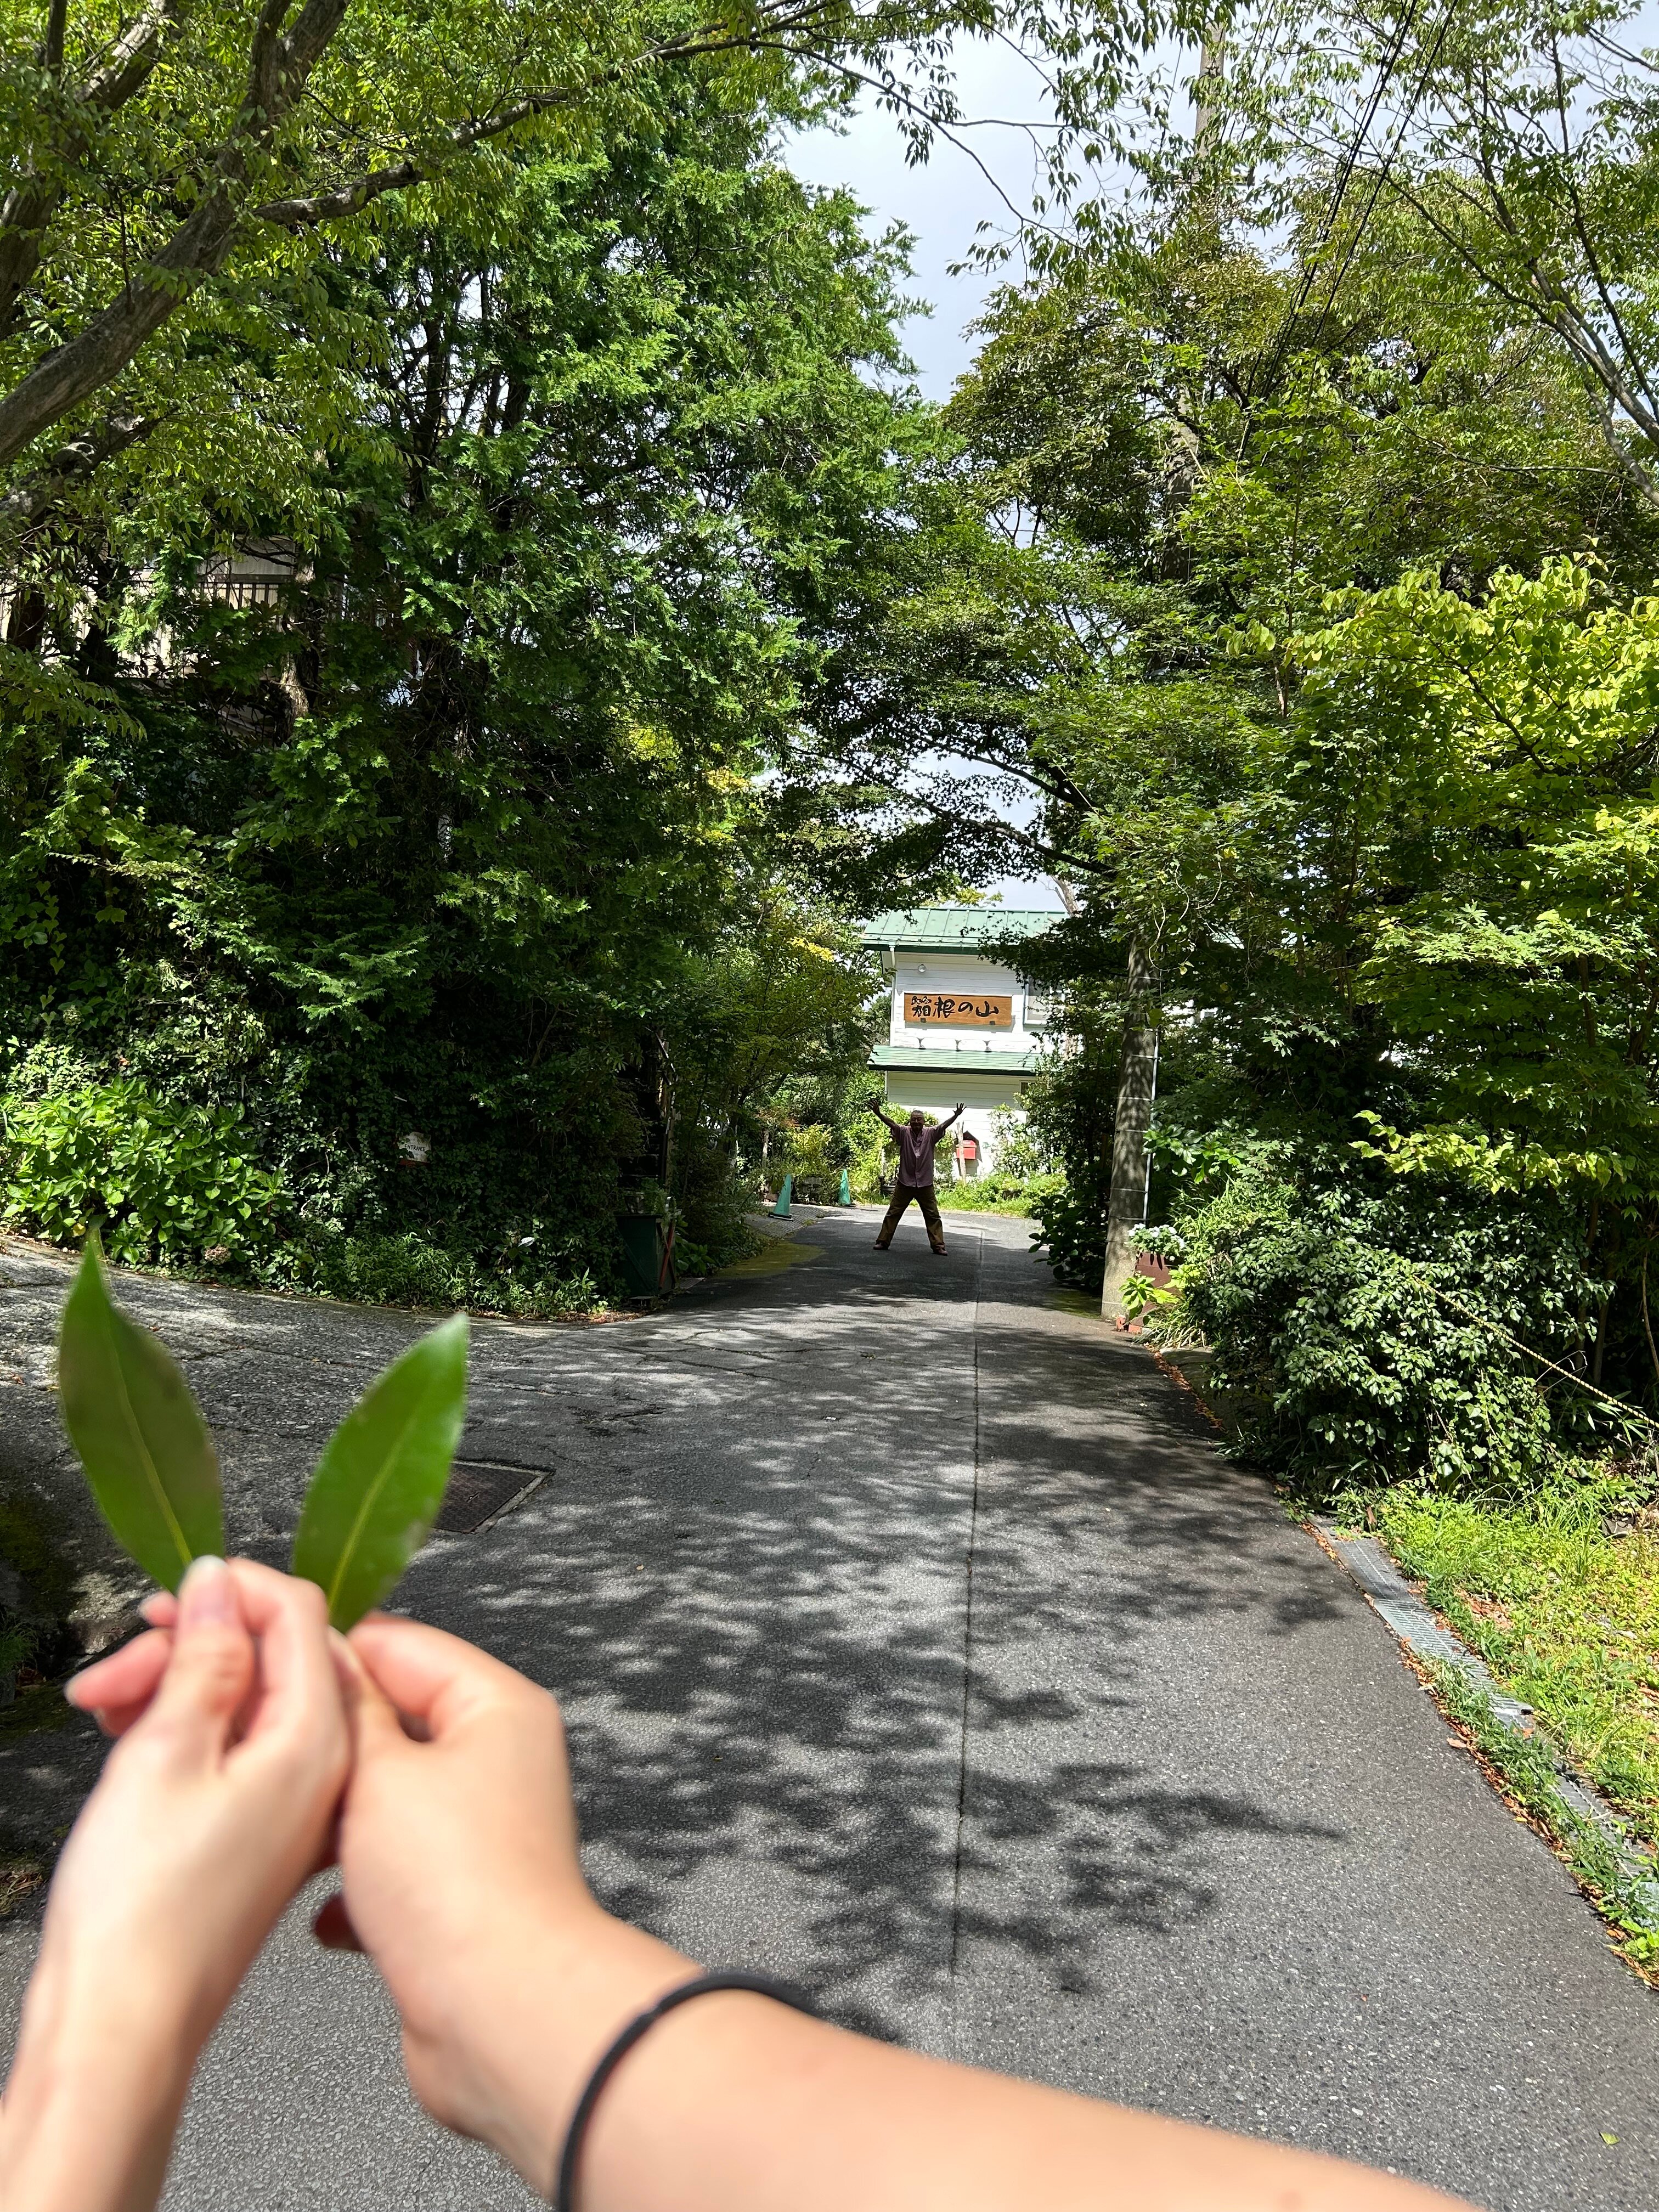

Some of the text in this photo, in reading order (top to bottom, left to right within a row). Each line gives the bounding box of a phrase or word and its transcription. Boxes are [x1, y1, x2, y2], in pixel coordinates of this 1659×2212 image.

[911, 995, 999, 1019] 箱根の山
[404, 1143, 425, 1152] ENTRANCE
